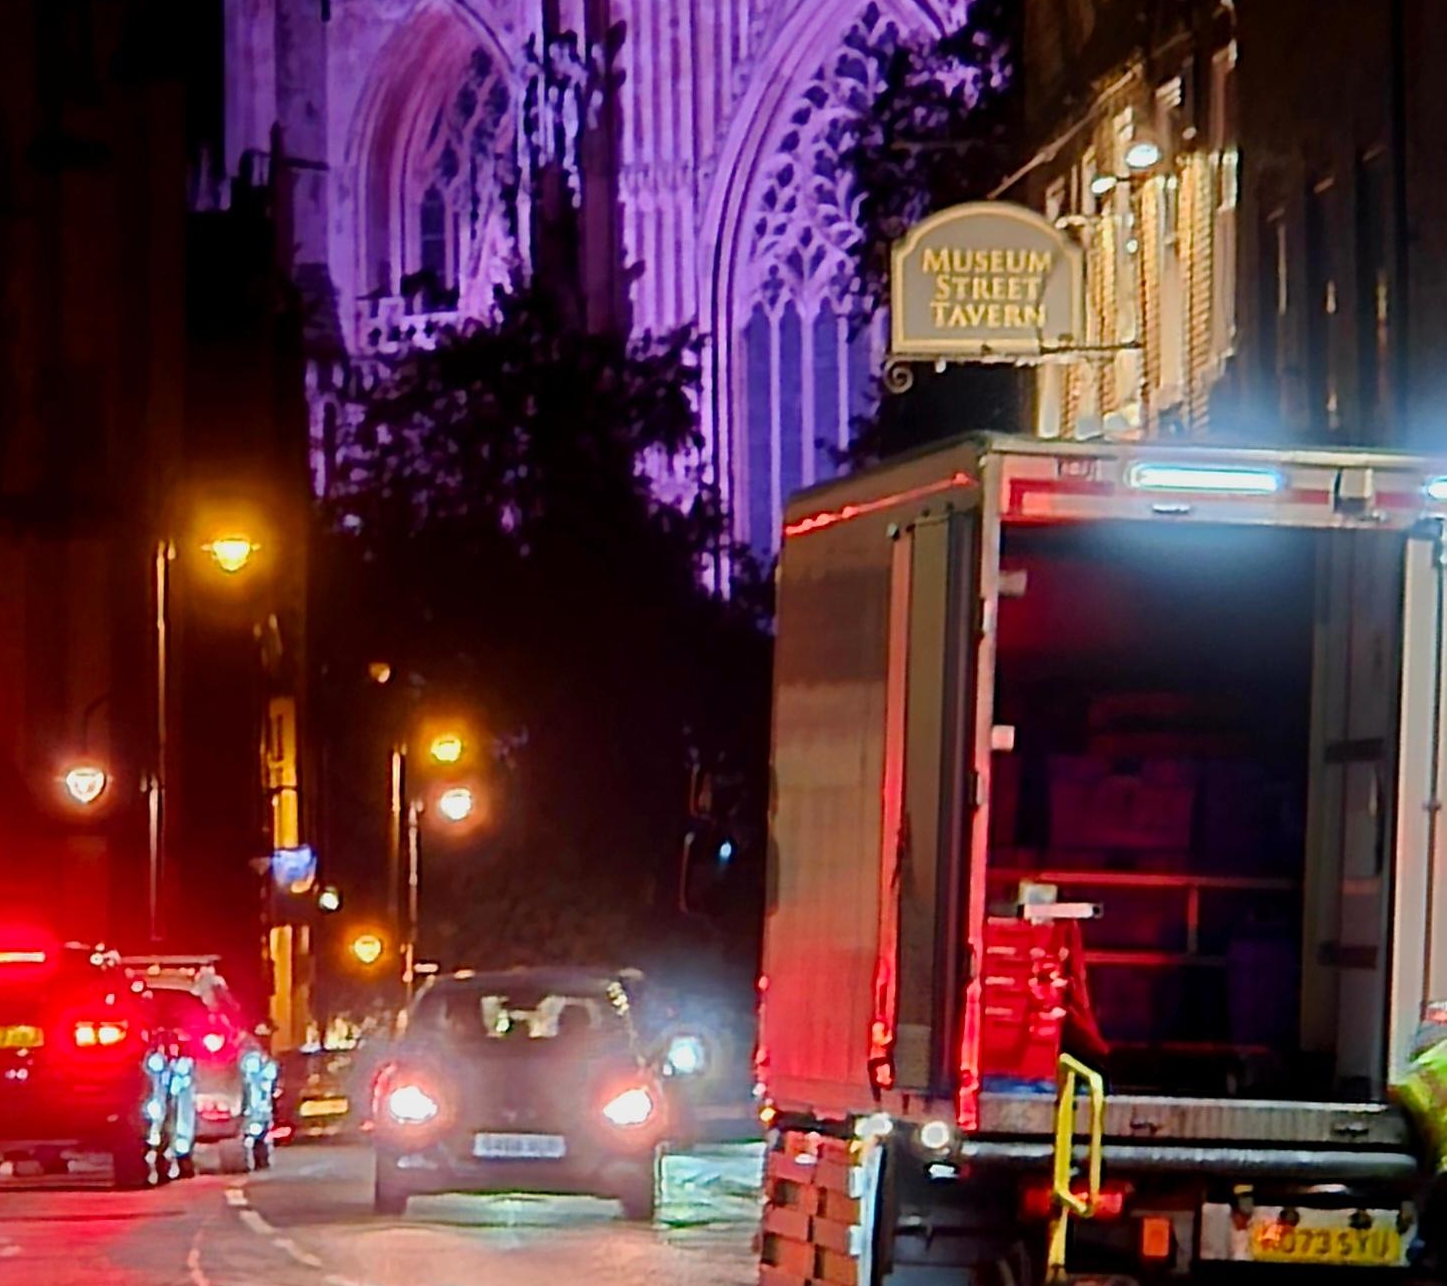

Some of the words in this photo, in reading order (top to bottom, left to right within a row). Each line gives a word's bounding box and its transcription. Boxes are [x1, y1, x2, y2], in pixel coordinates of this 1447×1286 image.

[922, 247, 1052, 273] MUSEUM
[935, 274, 1042, 301] STREET
[930, 302, 1047, 328] TAVERN
